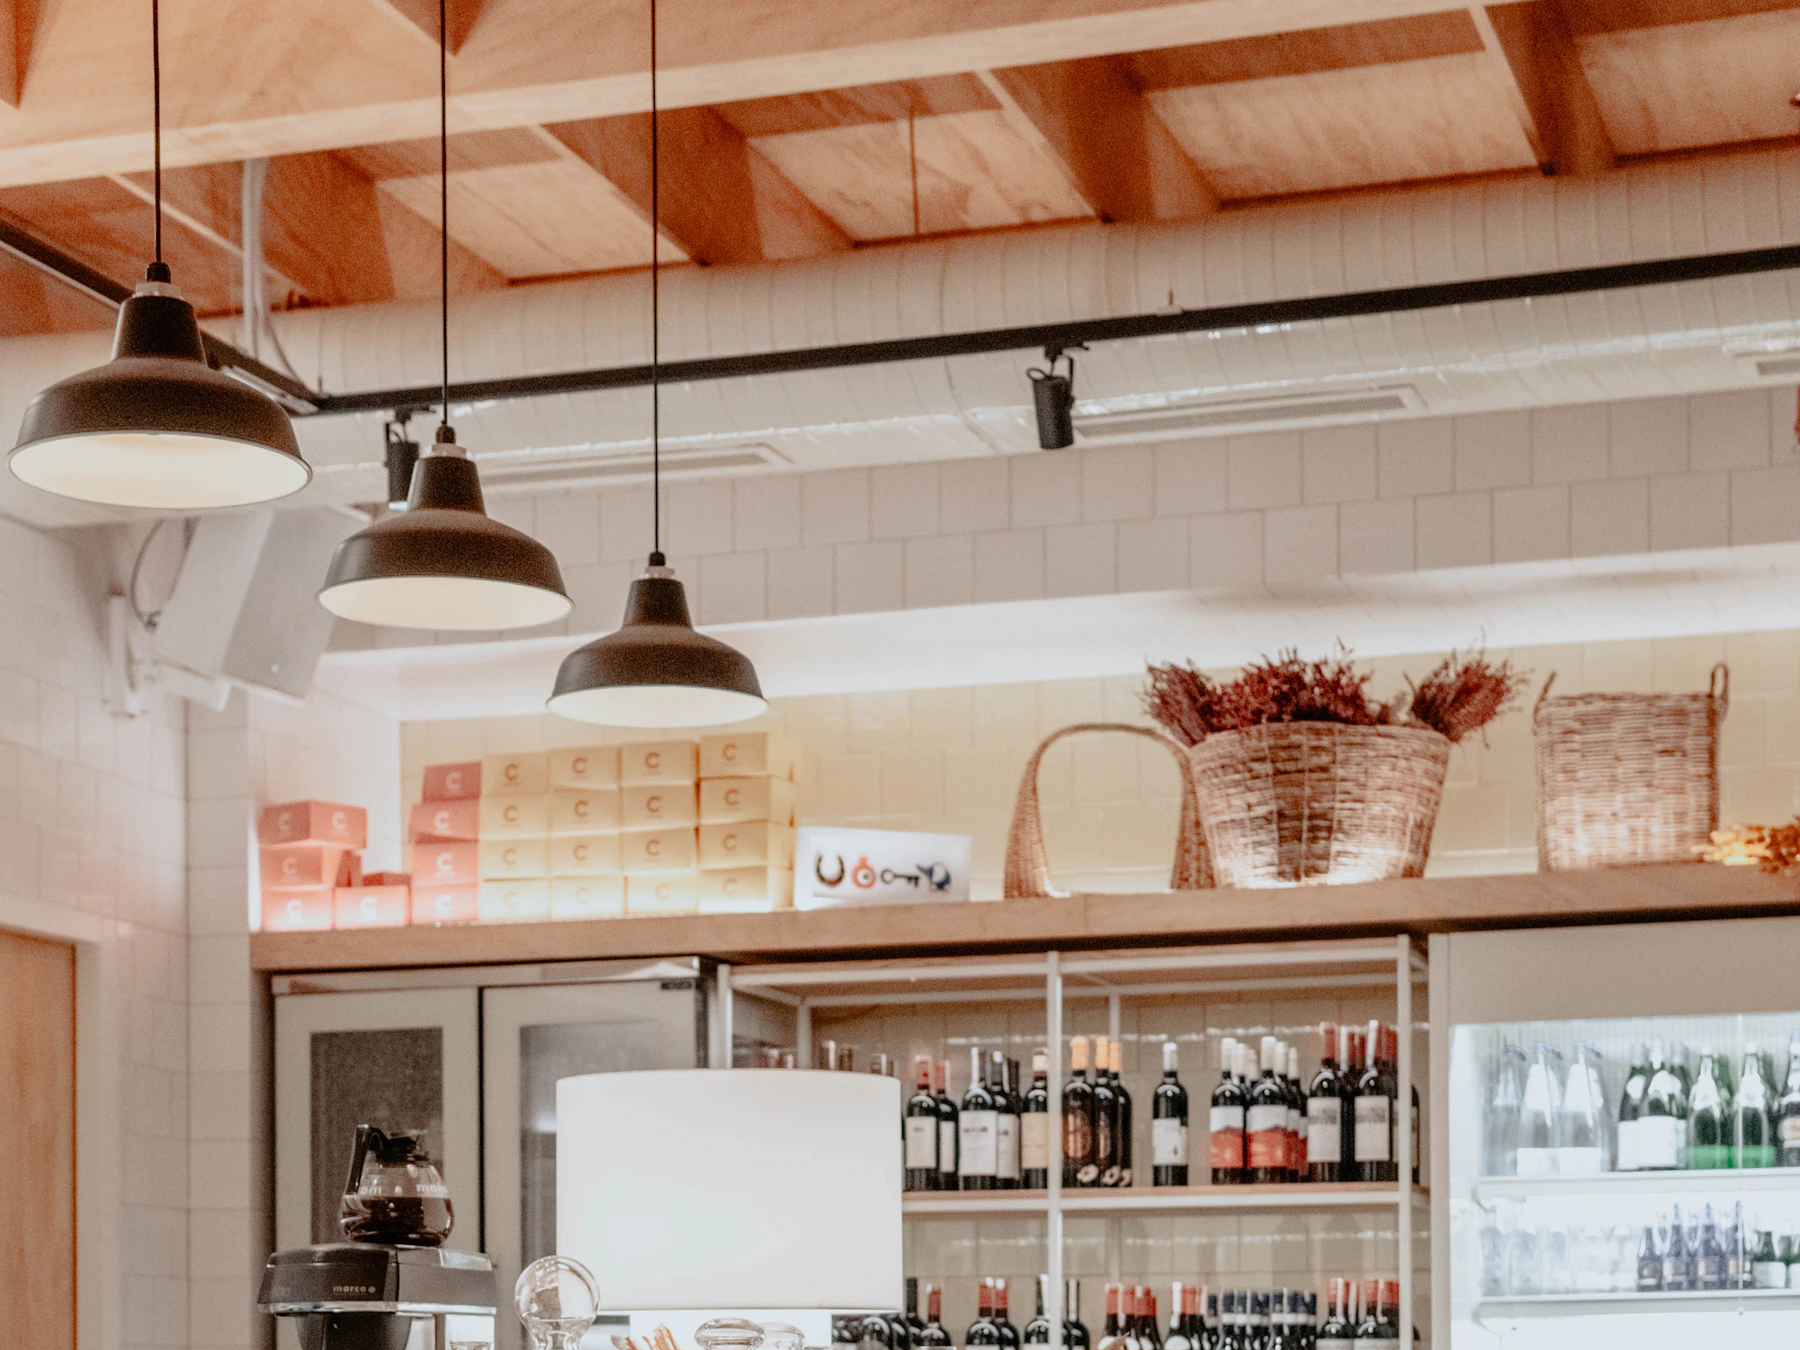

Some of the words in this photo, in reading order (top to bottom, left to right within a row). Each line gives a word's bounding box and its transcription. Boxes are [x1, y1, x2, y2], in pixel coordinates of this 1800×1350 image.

[645, 752, 660, 769] C
[722, 744, 737, 761] C
[504, 763, 518, 781] C
[572, 757, 587, 774] C
[446, 771, 462, 790] C
[646, 796, 661, 813] C
[724, 789, 739, 806] C
[503, 805, 518, 822] C
[574, 800, 588, 817] C
[332, 812, 347, 829] C
[434, 811, 450, 829] C
[645, 840, 660, 856] C
[723, 834, 737, 851] C
[503, 848, 517, 866] C
[573, 844, 588, 861] C
[436, 853, 453, 872] C
[575, 887, 588, 904] C
[655, 884, 670, 900] C
[723, 879, 737, 895] C
[503, 891, 517, 908] C
[333, 1285, 367, 1293] marco
